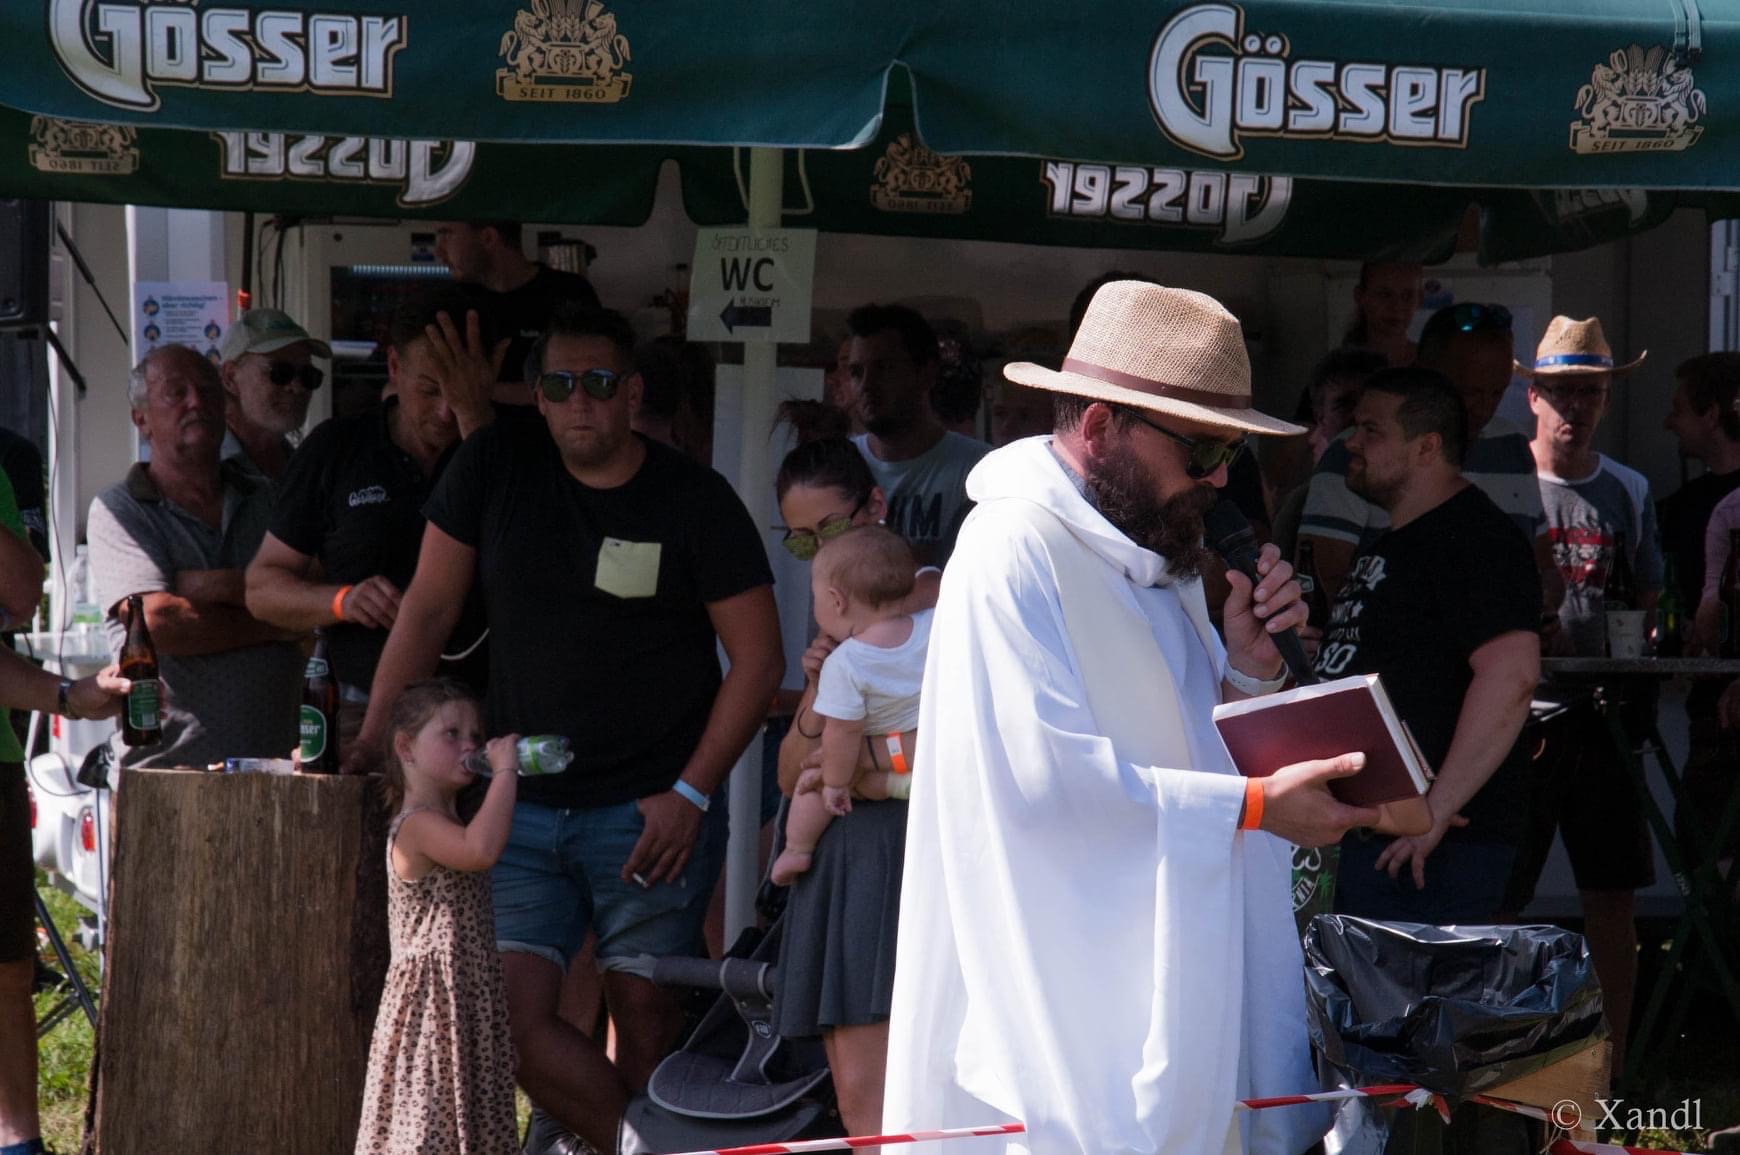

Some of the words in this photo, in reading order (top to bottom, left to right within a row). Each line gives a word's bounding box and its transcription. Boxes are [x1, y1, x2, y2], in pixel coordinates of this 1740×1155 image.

[1150, 3, 1486, 158] Gösser
[519, 88, 555, 99] SEIT
[565, 88, 606, 99] 1860
[1591, 140, 1627, 151] SEIT
[1635, 139, 1675, 150] 1860
[720, 256, 775, 292] WC
